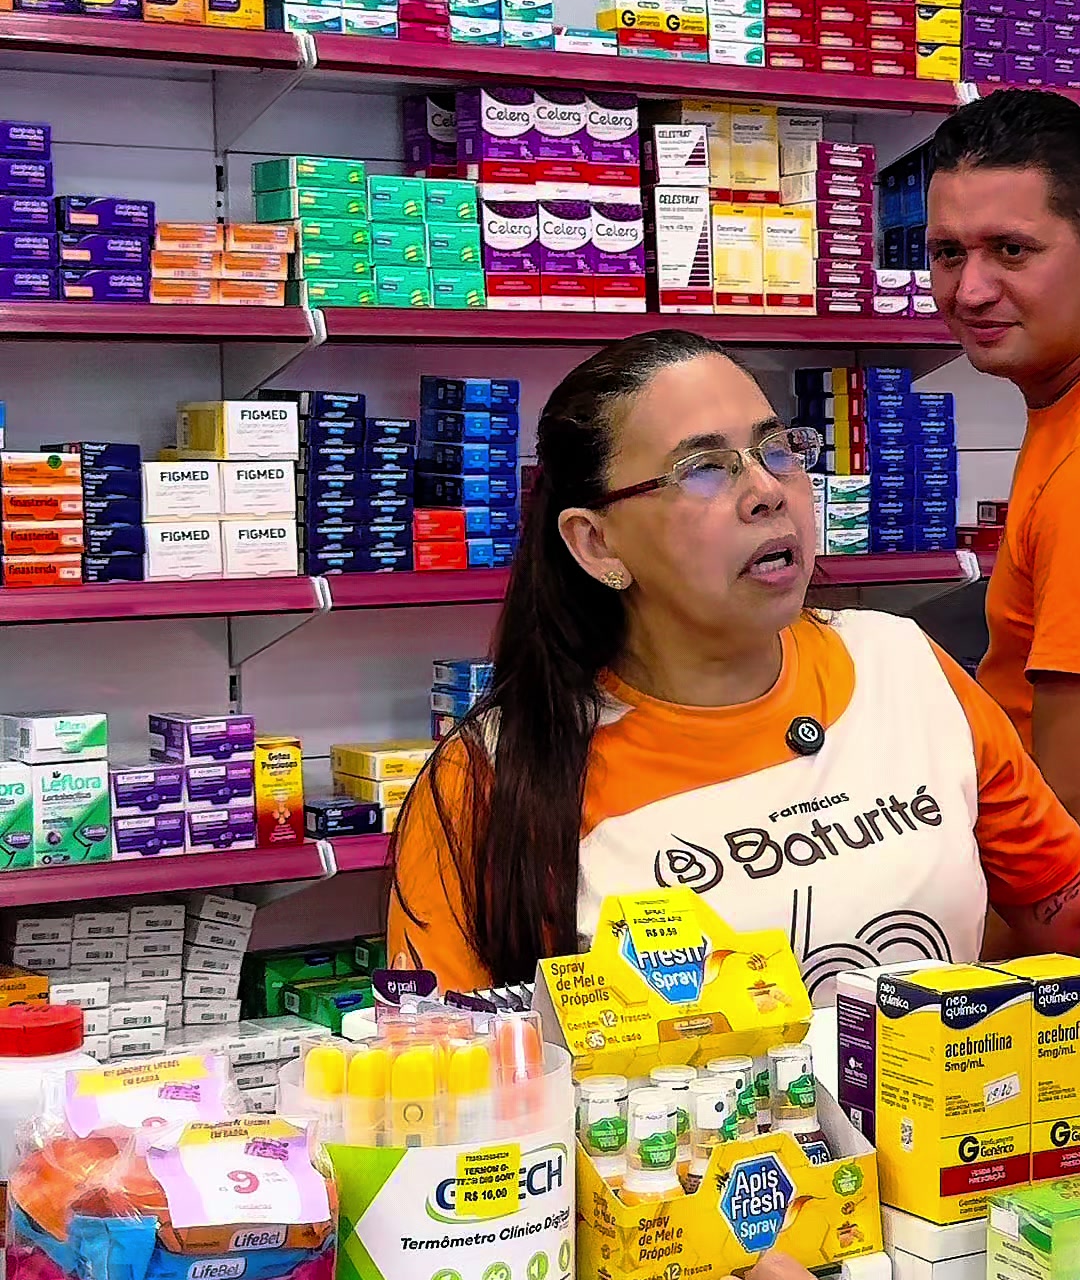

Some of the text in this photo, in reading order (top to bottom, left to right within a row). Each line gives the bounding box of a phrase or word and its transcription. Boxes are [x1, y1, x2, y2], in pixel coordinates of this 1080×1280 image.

[486, 106, 530, 125] Celerg
[536, 106, 581, 125] Celerg
[588, 111, 633, 130] Celerg
[488, 221, 532, 241] Celerg
[543, 220, 587, 240] Celerg
[596, 223, 638, 241] Celerg
[241, 410, 288, 420] FIGMED
[160, 471, 209, 482] FIGMED
[236, 469, 284, 480] FIGMED
[161, 530, 210, 542] FIGMED
[238, 528, 286, 540] FIGMED
[724, 786, 943, 879] Baturité
[551, 962, 584, 977] Spray
[556, 976, 605, 991] de Mel e
[651, 969, 697, 991] Spray
[880, 982, 896, 994] neo
[1039, 983, 1059, 995] neo
[945, 996, 968, 1007] neo
[1039, 990, 1079, 1005] química
[602, 1011, 615, 1026] 12
[945, 1004, 987, 1020] química
[945, 1032, 1012, 1059] acebrofilina
[1037, 1045, 1076, 1059] 5mg/mL
[945, 1058, 984, 1072] 5mg/mL
[1051, 1121, 1072, 1147] G
[810, 1152, 828, 1165] pis
[959, 1136, 980, 1163] G
[227, 1170, 260, 1193] 9
[735, 1167, 779, 1197] Apis
[464, 1191, 478, 1201] R$
[731, 1187, 785, 1220] Fresh
[638, 1215, 670, 1235] Spray
[740, 1217, 778, 1240] Spray
[234, 1231, 281, 1249] LifeBel
[401, 1231, 496, 1250] Termômetro
[500, 1221, 542, 1242] Clínico
[639, 1231, 653, 1246] de
[655, 1228, 674, 1244] Mel
[638, 1243, 683, 1262] Própolis
[191, 1263, 240, 1278] LifeBel
[665, 1265, 681, 1280] 12
